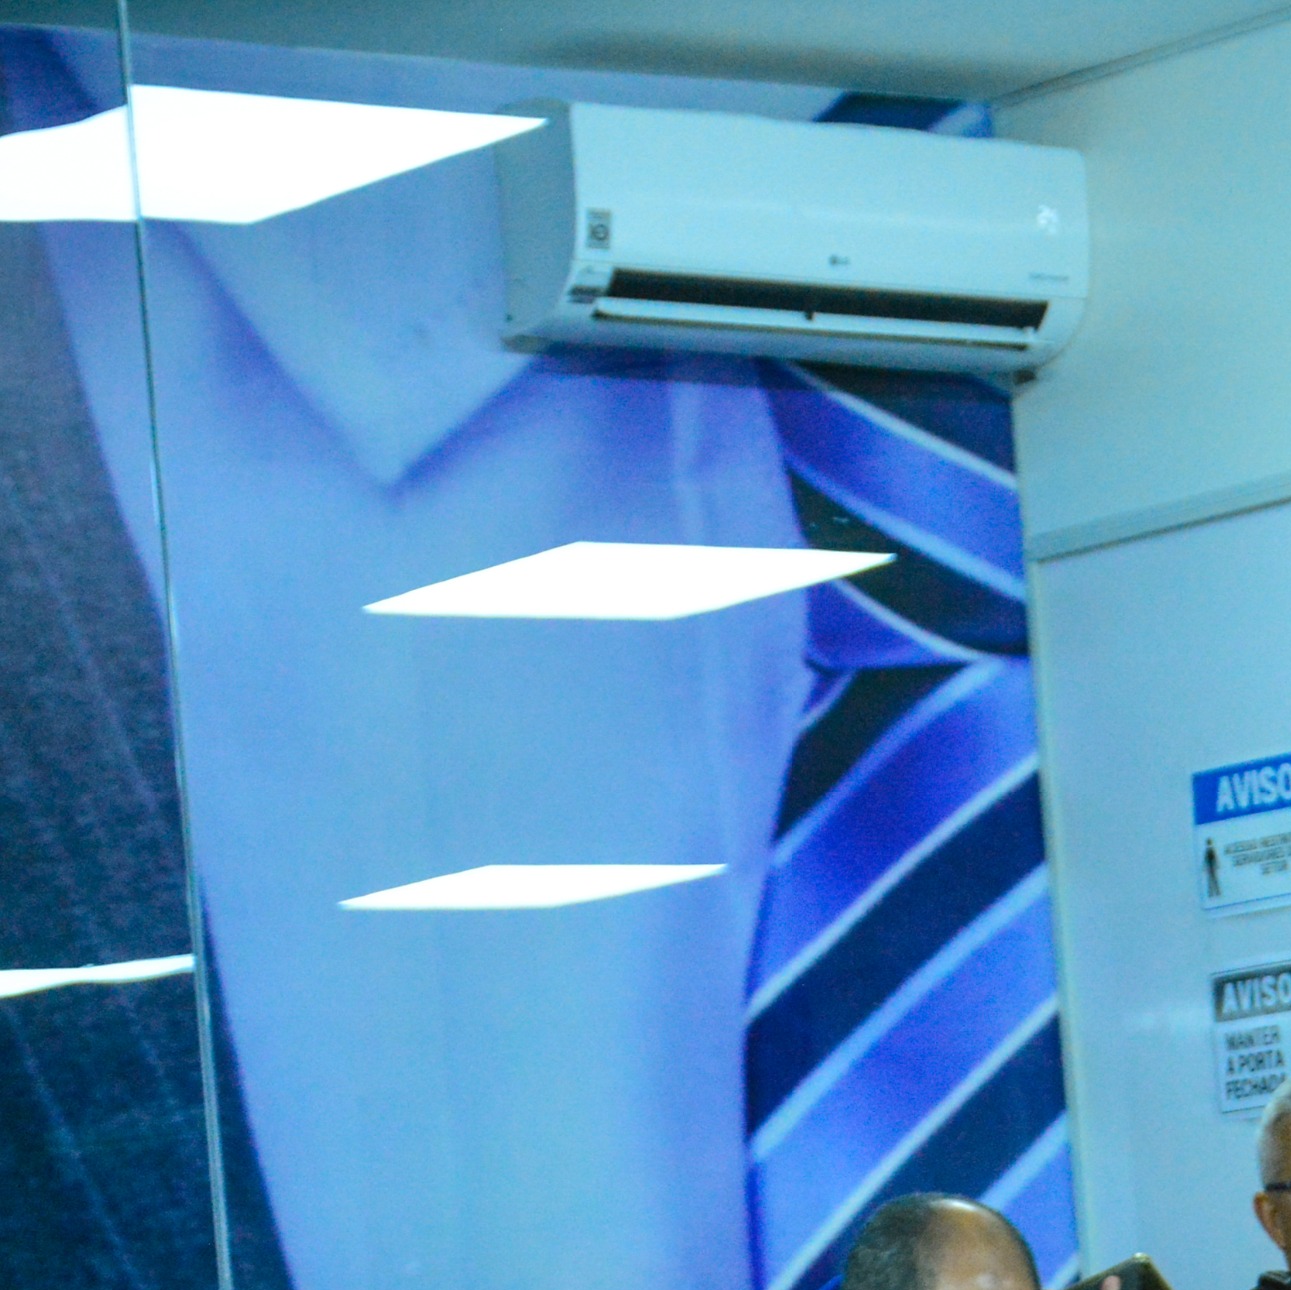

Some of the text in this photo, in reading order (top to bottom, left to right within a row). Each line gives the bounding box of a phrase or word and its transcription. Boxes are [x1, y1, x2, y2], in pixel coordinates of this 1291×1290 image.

[1226, 1025, 1280, 1050] MANTER
[1226, 1049, 1285, 1075] A PORTA
